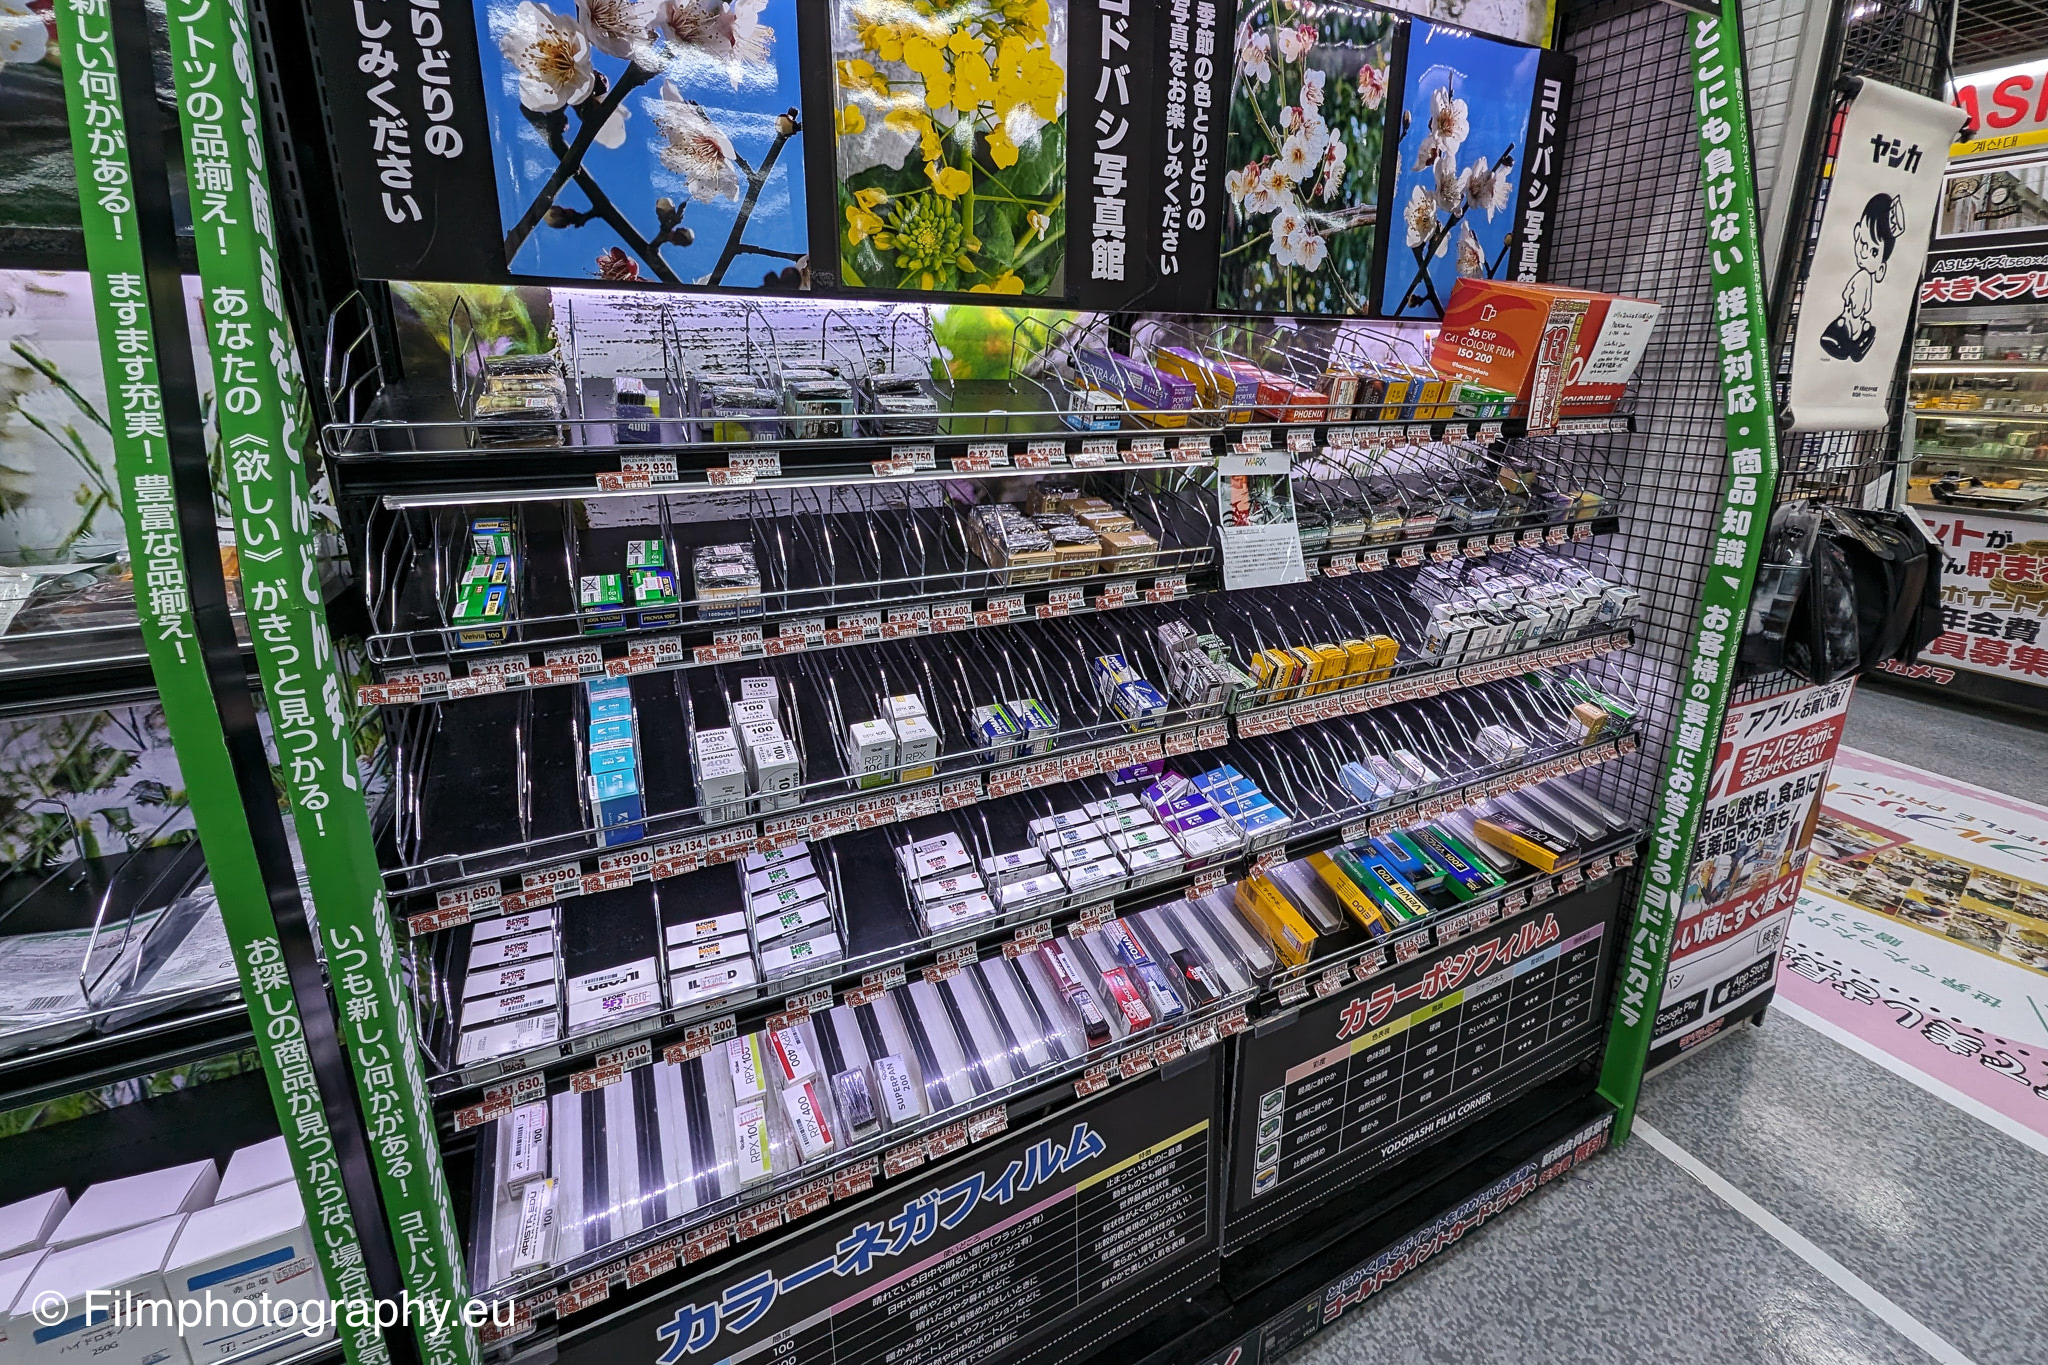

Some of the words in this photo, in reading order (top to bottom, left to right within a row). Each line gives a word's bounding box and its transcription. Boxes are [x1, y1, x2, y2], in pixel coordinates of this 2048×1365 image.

[410, 0, 464, 159] りどりの
[1870, 133, 1925, 174] ヤシカ
[1971, 135, 2019, 154] 계산대
[1468, 327, 1481, 337] 36
[1481, 330, 1497, 341] EXP
[1444, 332, 1458, 344] C41
[1460, 337, 1495, 354] COLOUR
[1495, 344, 1515, 359] FILM
[1457, 347, 1473, 359] ISO
[1474, 351, 1493, 364] 200
[1293, 409, 1324, 419] PHOENIX
[462, 632, 485, 641] Velvia
[487, 631, 500, 640] 100
[748, 681, 768, 690] 100
[742, 703, 764, 713] 100
[701, 734, 725, 744] 400
[751, 725, 774, 735] 100
[706, 757, 731, 767] 400
[905, 751, 927, 761] RPX
[1335, 912, 1560, 1042] カラーポジフィルム
[787, 1048, 801, 1067] 400
[886, 1062, 906, 1111] SUPERPAN
[899, 1074, 911, 1091] 200
[797, 1095, 812, 1116] 400
[1380, 1120, 1436, 1158] YODOBASHI
[1435, 1109, 1457, 1132] FILM
[1457, 1091, 1492, 1118] CORNER
[542, 1209, 553, 1229] 100
[655, 1121, 1107, 1365] カラーネガフィルム
[772, 1339, 795, 1357] 100
